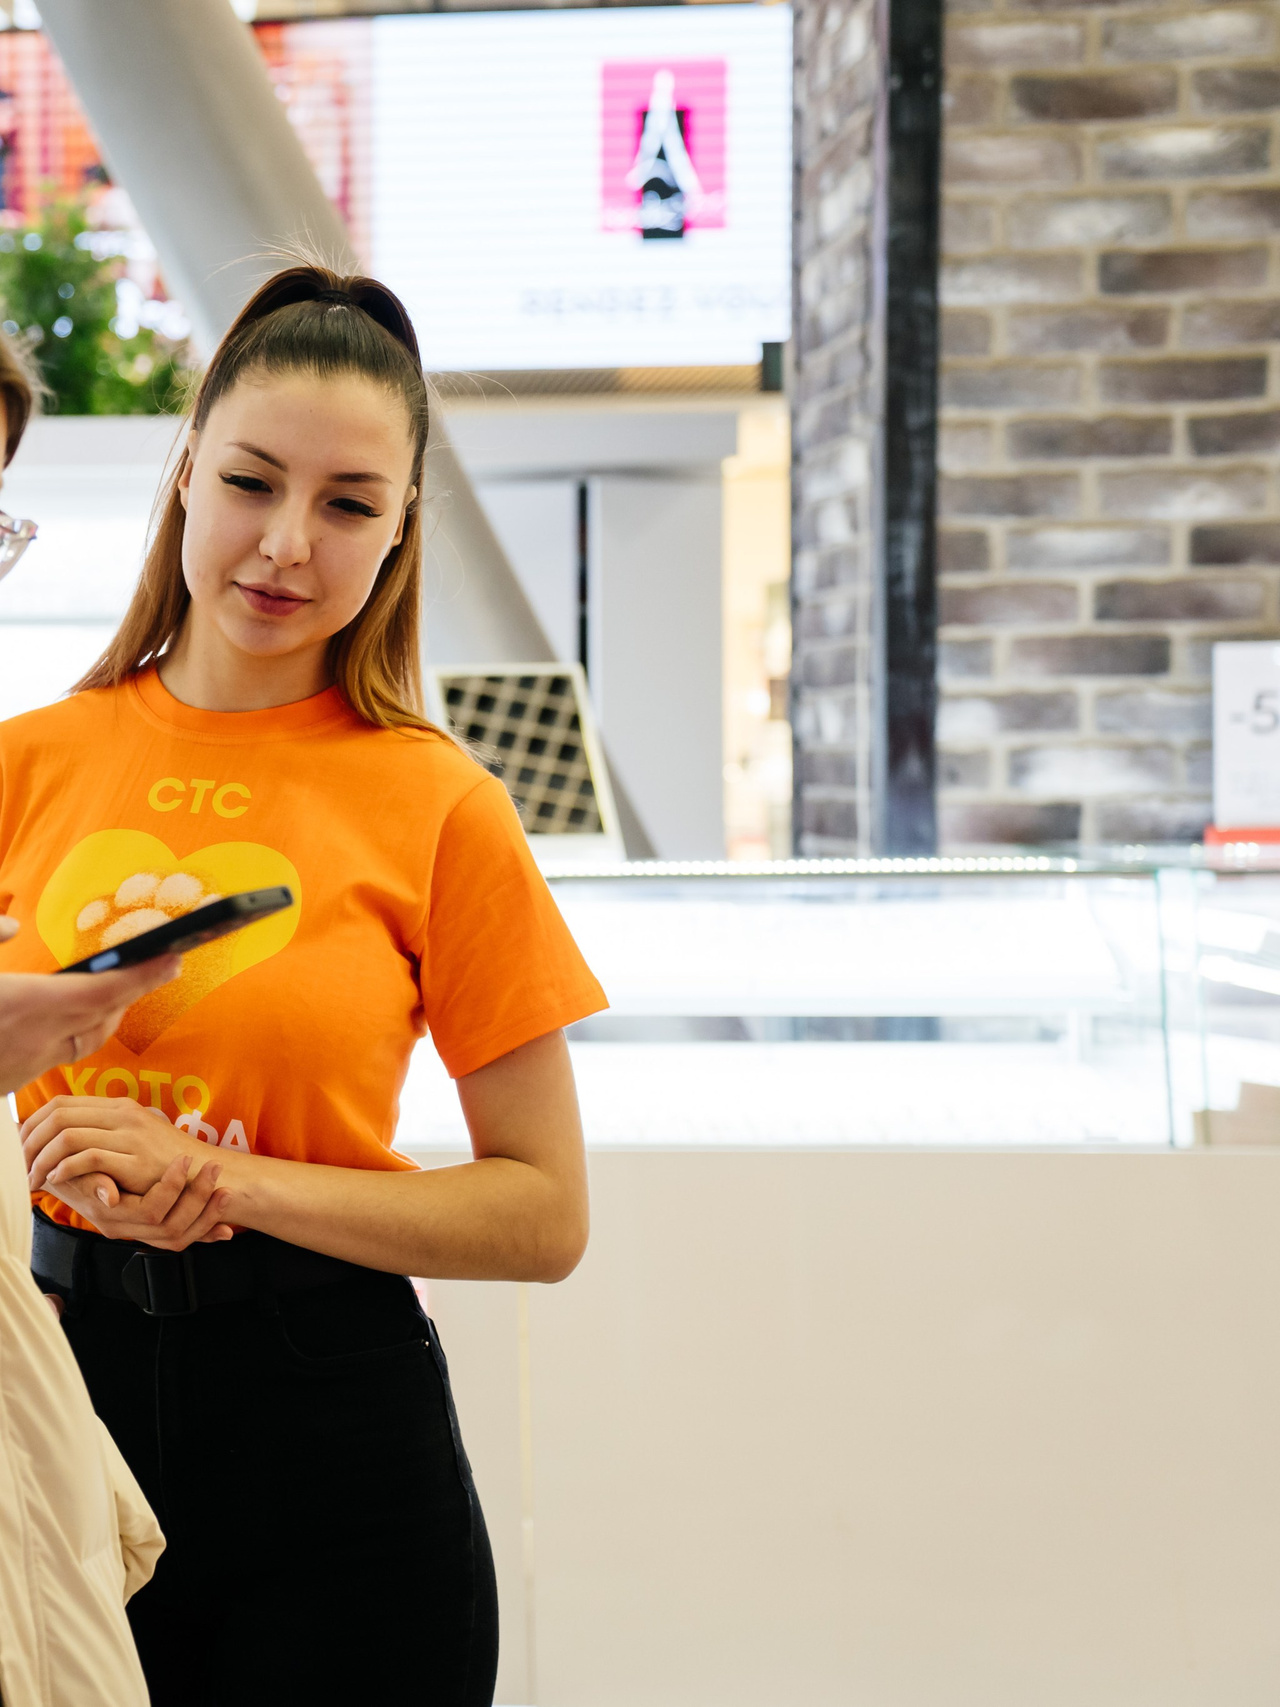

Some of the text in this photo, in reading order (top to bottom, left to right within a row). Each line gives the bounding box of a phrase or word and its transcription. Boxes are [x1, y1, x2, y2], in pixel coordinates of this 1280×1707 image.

[147, 777, 252, 818] СТС
[63, 1066, 211, 1116] КОТО
[143, 1107, 251, 1154] ФА
